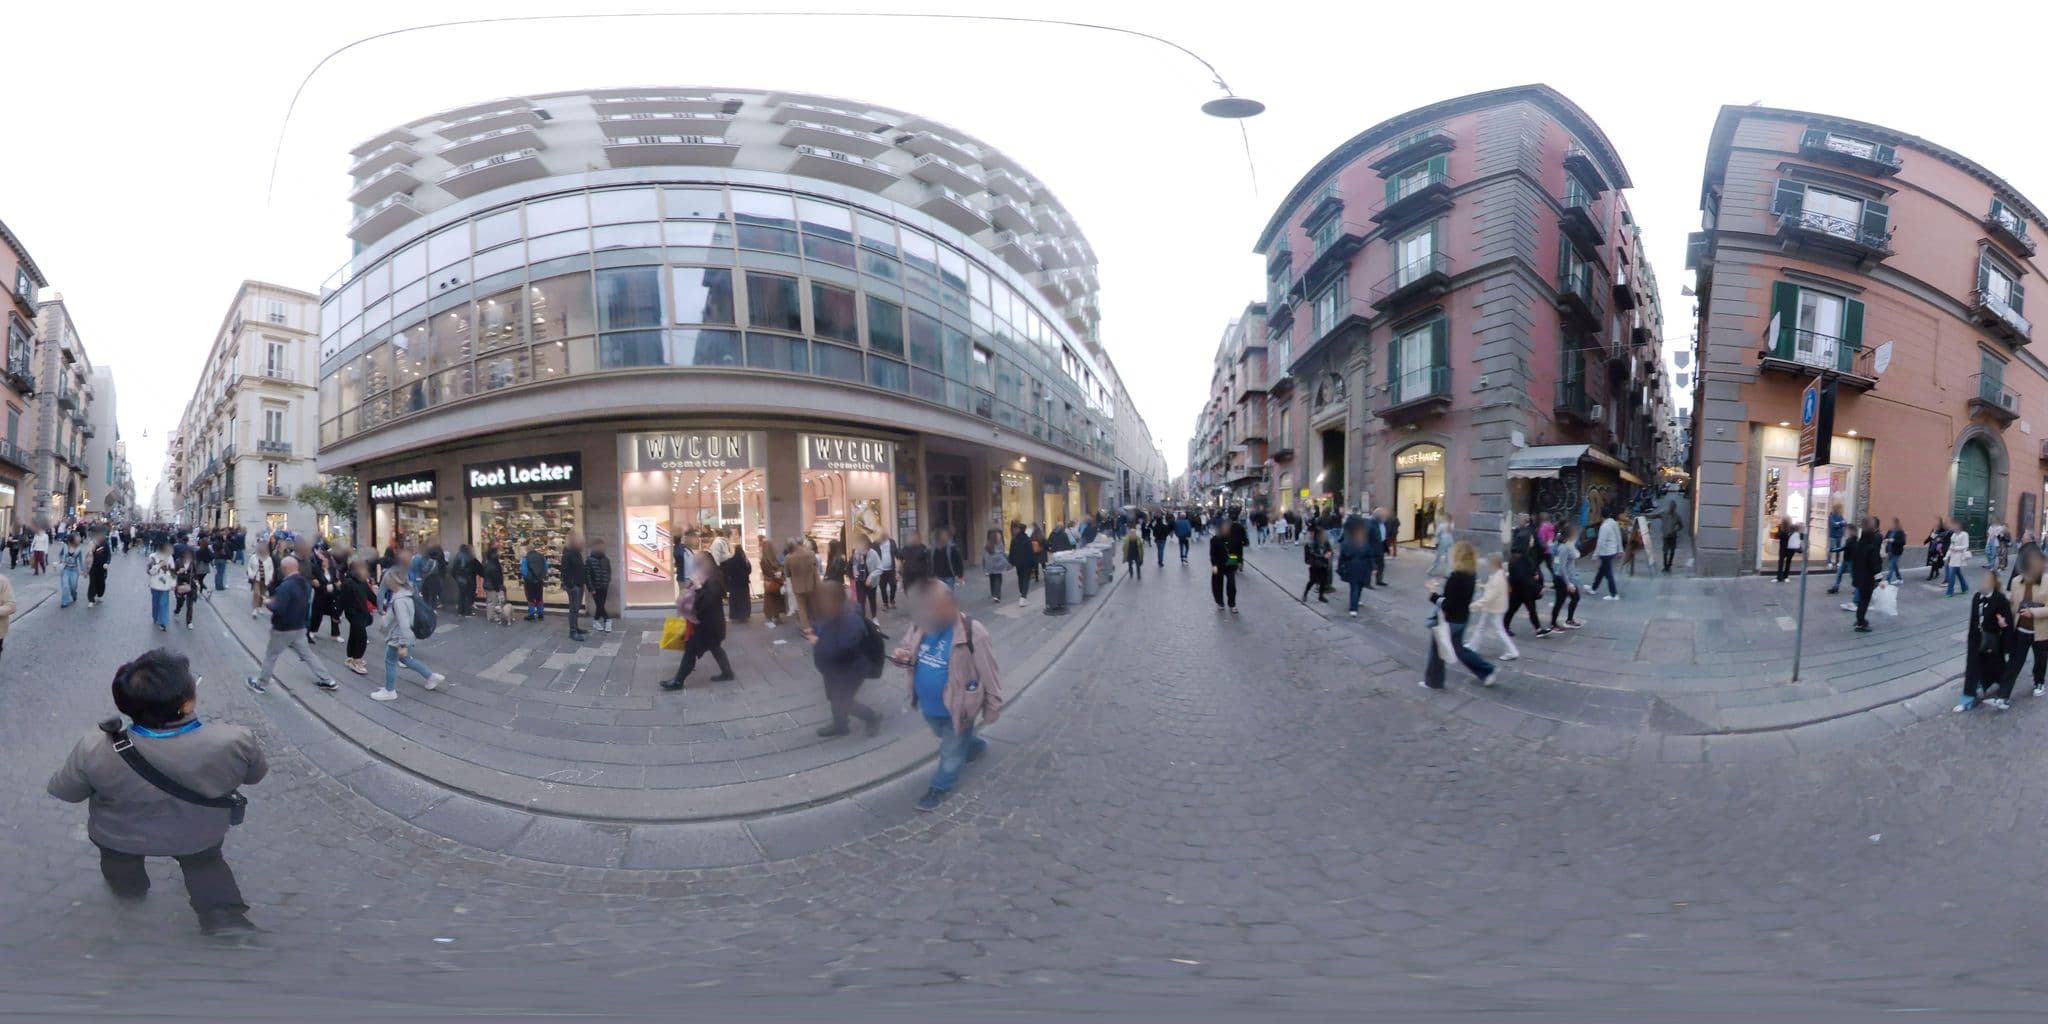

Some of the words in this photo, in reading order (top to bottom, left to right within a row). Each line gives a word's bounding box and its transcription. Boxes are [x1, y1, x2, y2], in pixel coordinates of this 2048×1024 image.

[646, 435, 741, 459] WYCON
[661, 460, 726, 469] cosmetics
[828, 461, 875, 471] cosmetics
[470, 468, 506, 487] Foot
[510, 462, 573, 483] Locker
[371, 484, 393, 498] Foot
[394, 479, 433, 496] Locker
[638, 524, 649, 540] 3
